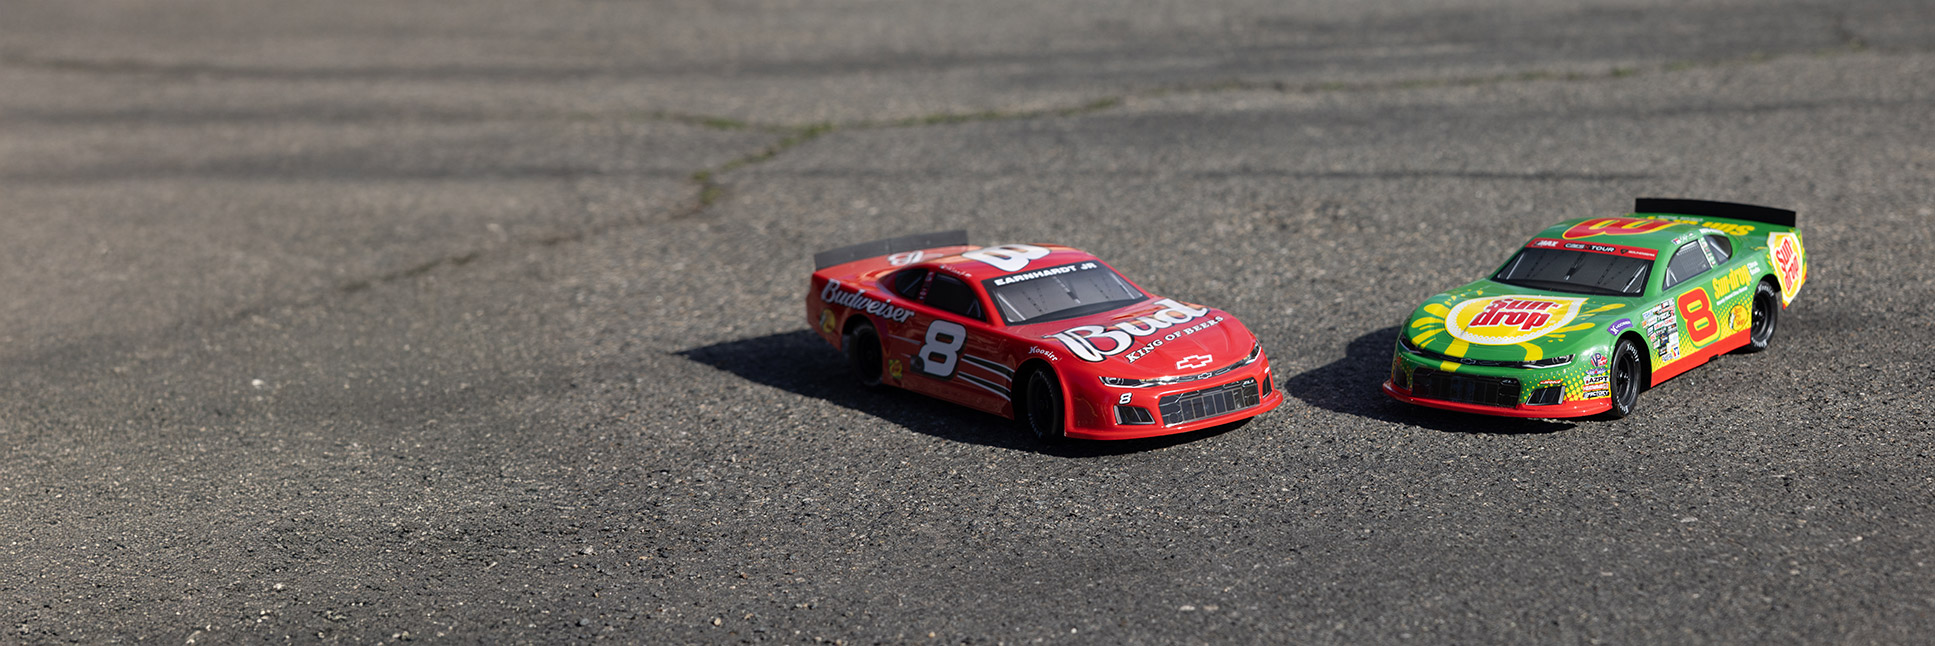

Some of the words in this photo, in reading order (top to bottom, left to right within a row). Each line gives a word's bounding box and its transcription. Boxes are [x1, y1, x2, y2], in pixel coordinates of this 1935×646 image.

[1591, 245, 1616, 253] TOUR
[994, 264, 1077, 286] EARNHARDT
[1080, 262, 1098, 270] JR
[820, 277, 915, 322] Budweiser
[1469, 310, 1551, 331] drop
[1677, 285, 1721, 348] 8
[917, 319, 968, 379] 8
[1043, 297, 1211, 363] Bud
[1125, 337, 1164, 364] KING
[1164, 328, 1183, 342] OF
[1184, 315, 1225, 336] BEERS
[1119, 392, 1133, 405] 8
